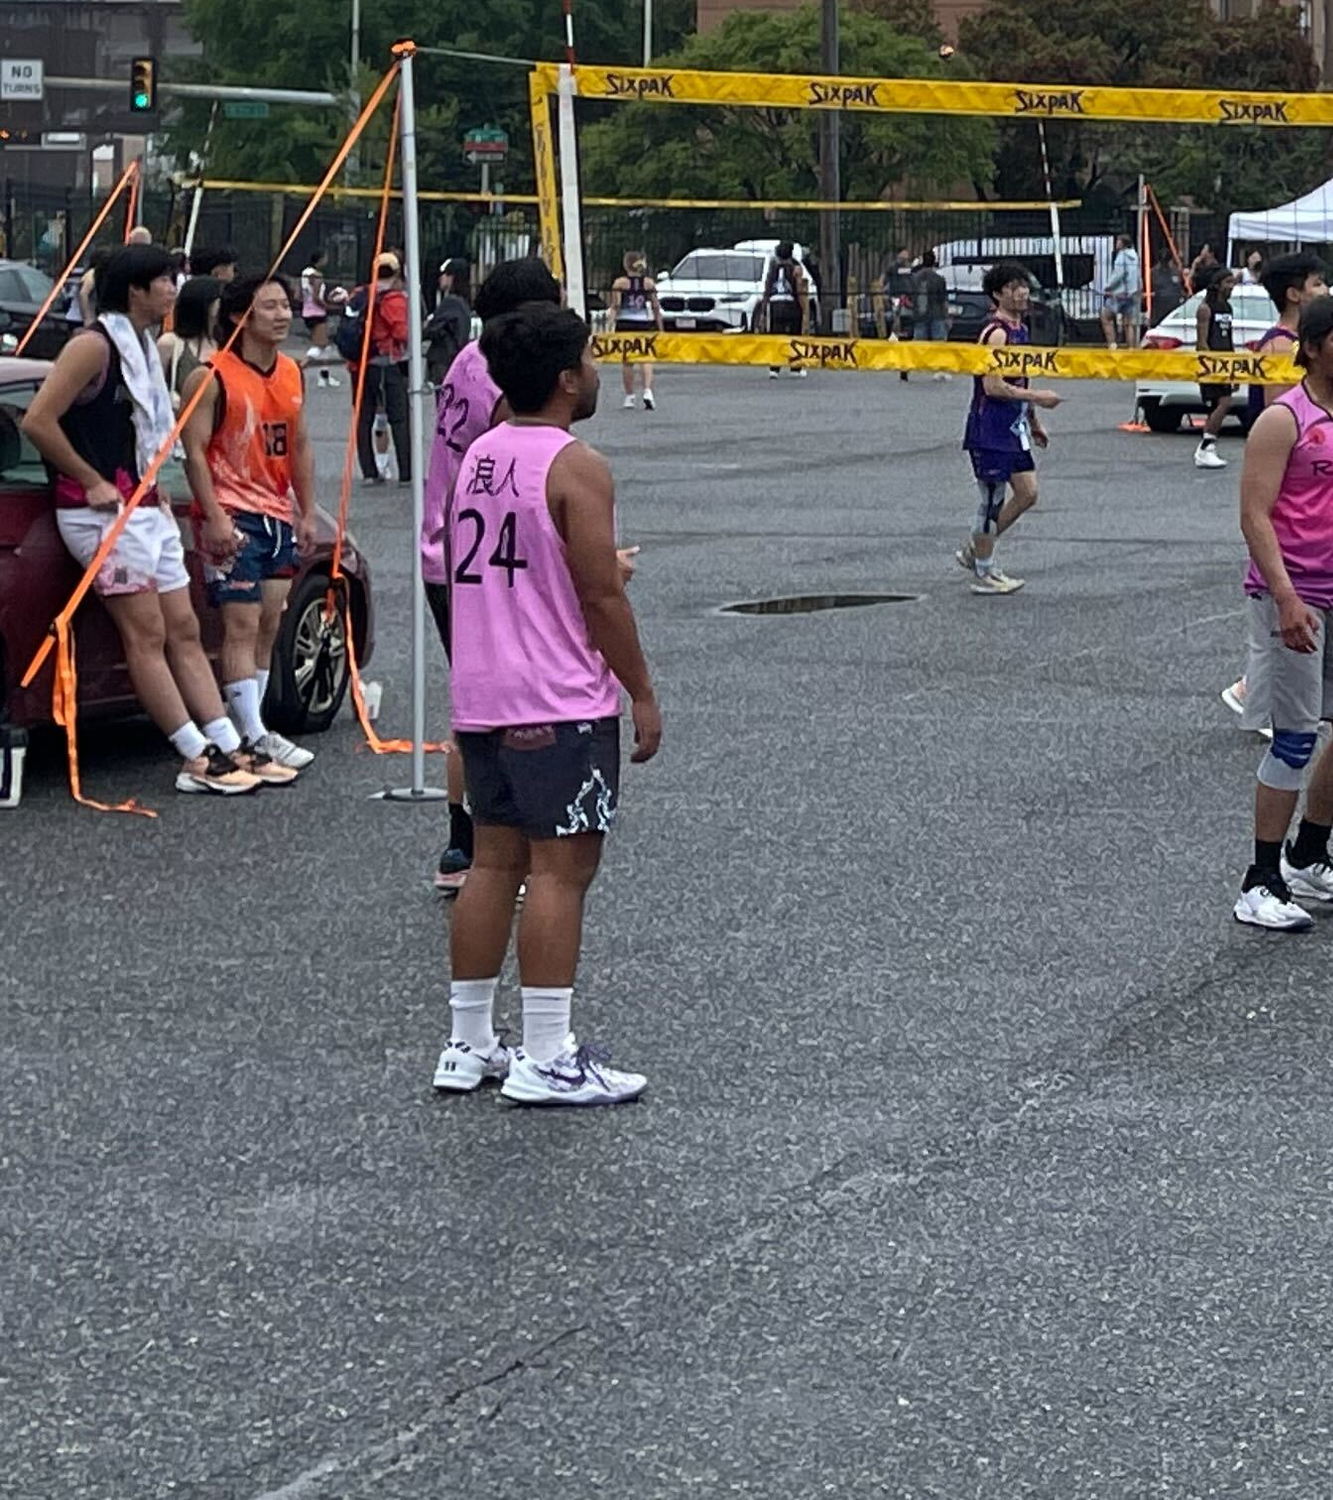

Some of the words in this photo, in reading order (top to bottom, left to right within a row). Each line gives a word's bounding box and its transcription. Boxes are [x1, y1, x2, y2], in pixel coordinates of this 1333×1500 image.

[11, 65, 33, 78] NO
[466, 454, 521, 498] 浪人
[453, 508, 528, 589] 24
